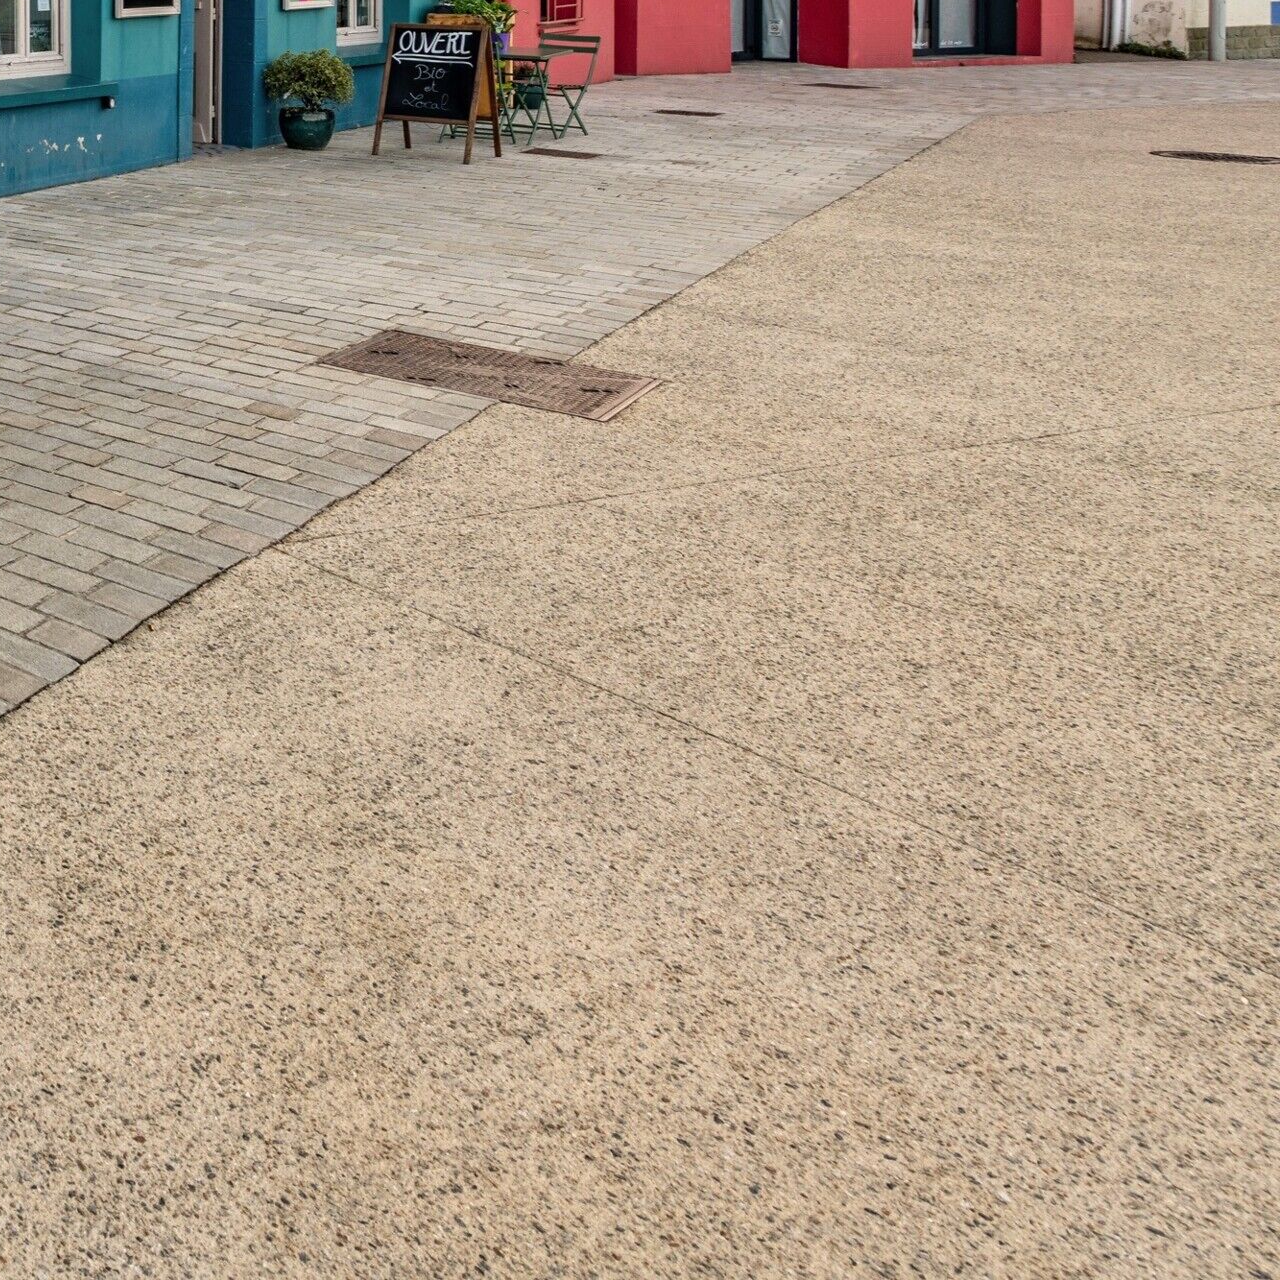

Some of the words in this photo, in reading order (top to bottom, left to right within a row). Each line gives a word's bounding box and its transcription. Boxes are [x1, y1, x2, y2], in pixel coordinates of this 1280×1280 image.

[399, 29, 473, 55] OUVERT
[413, 64, 446, 80] Bio
[401, 92, 450, 111] Local
